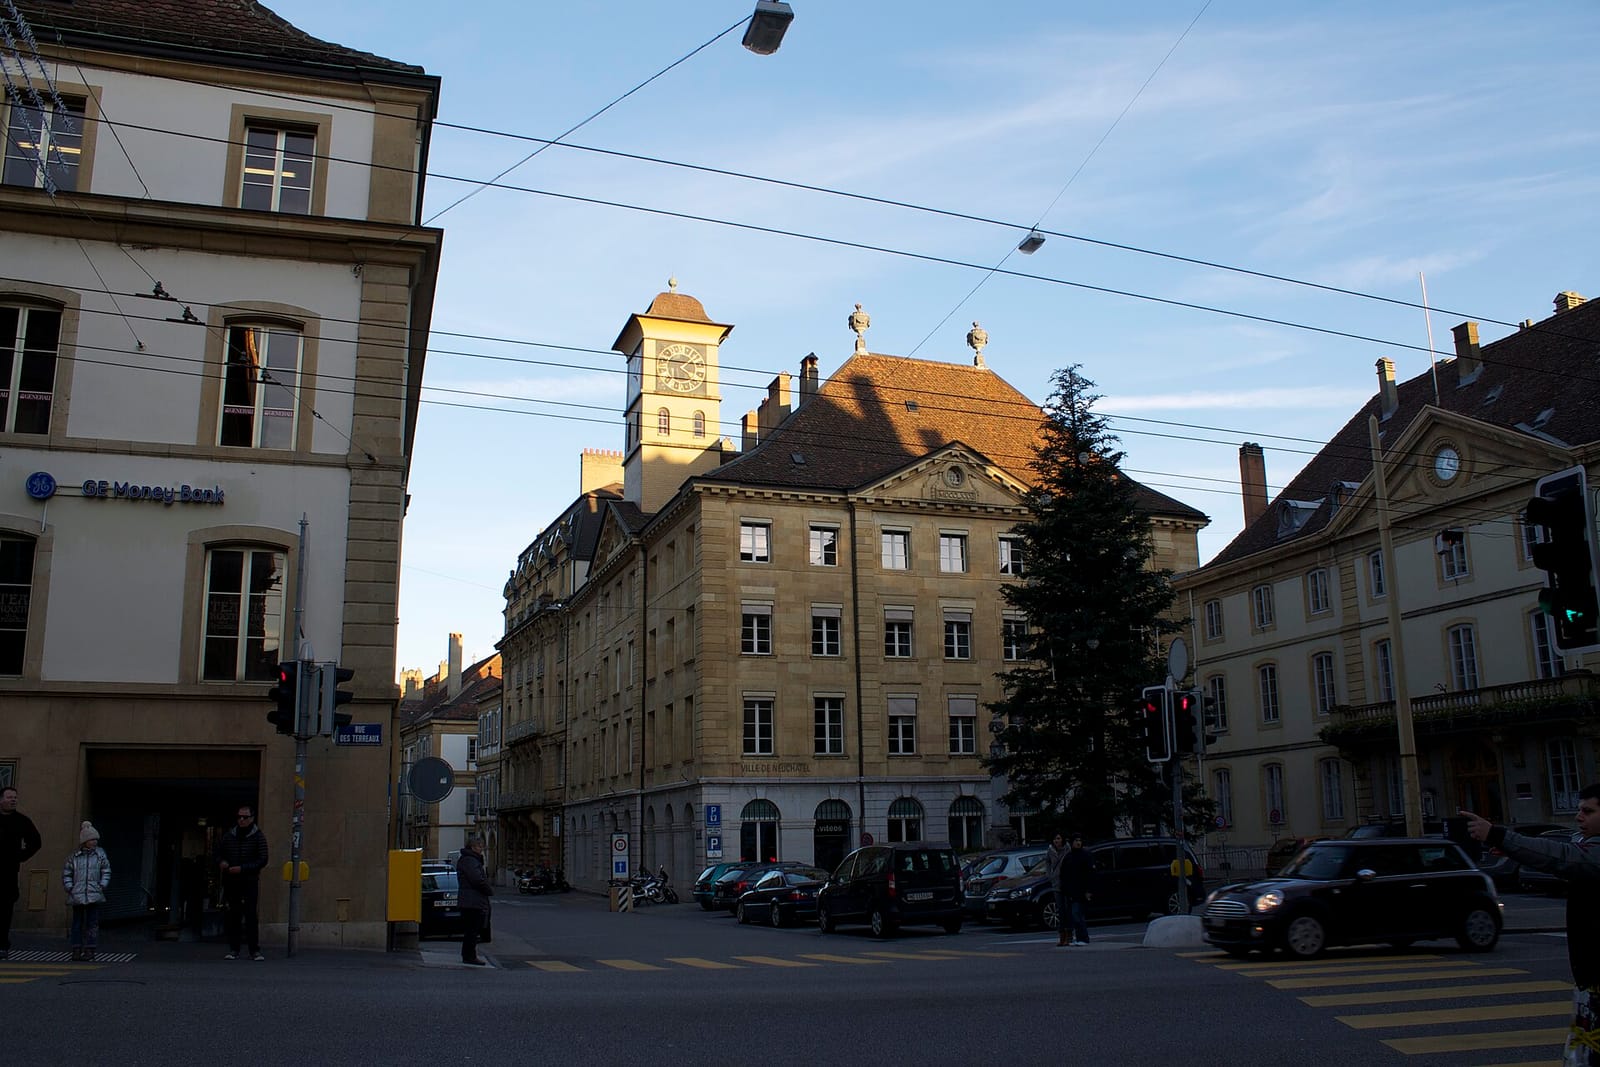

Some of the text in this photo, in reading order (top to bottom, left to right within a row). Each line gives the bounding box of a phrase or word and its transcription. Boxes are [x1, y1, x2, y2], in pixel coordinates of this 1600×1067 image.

[82, 480, 225, 505] GE Money Bank
[354, 725, 366, 733] RUE
[340, 734, 380, 743] DES TERREAUX
[741, 764, 759, 773] VILLE
[761, 764, 771, 773] DE
[710, 837, 719, 850] P
